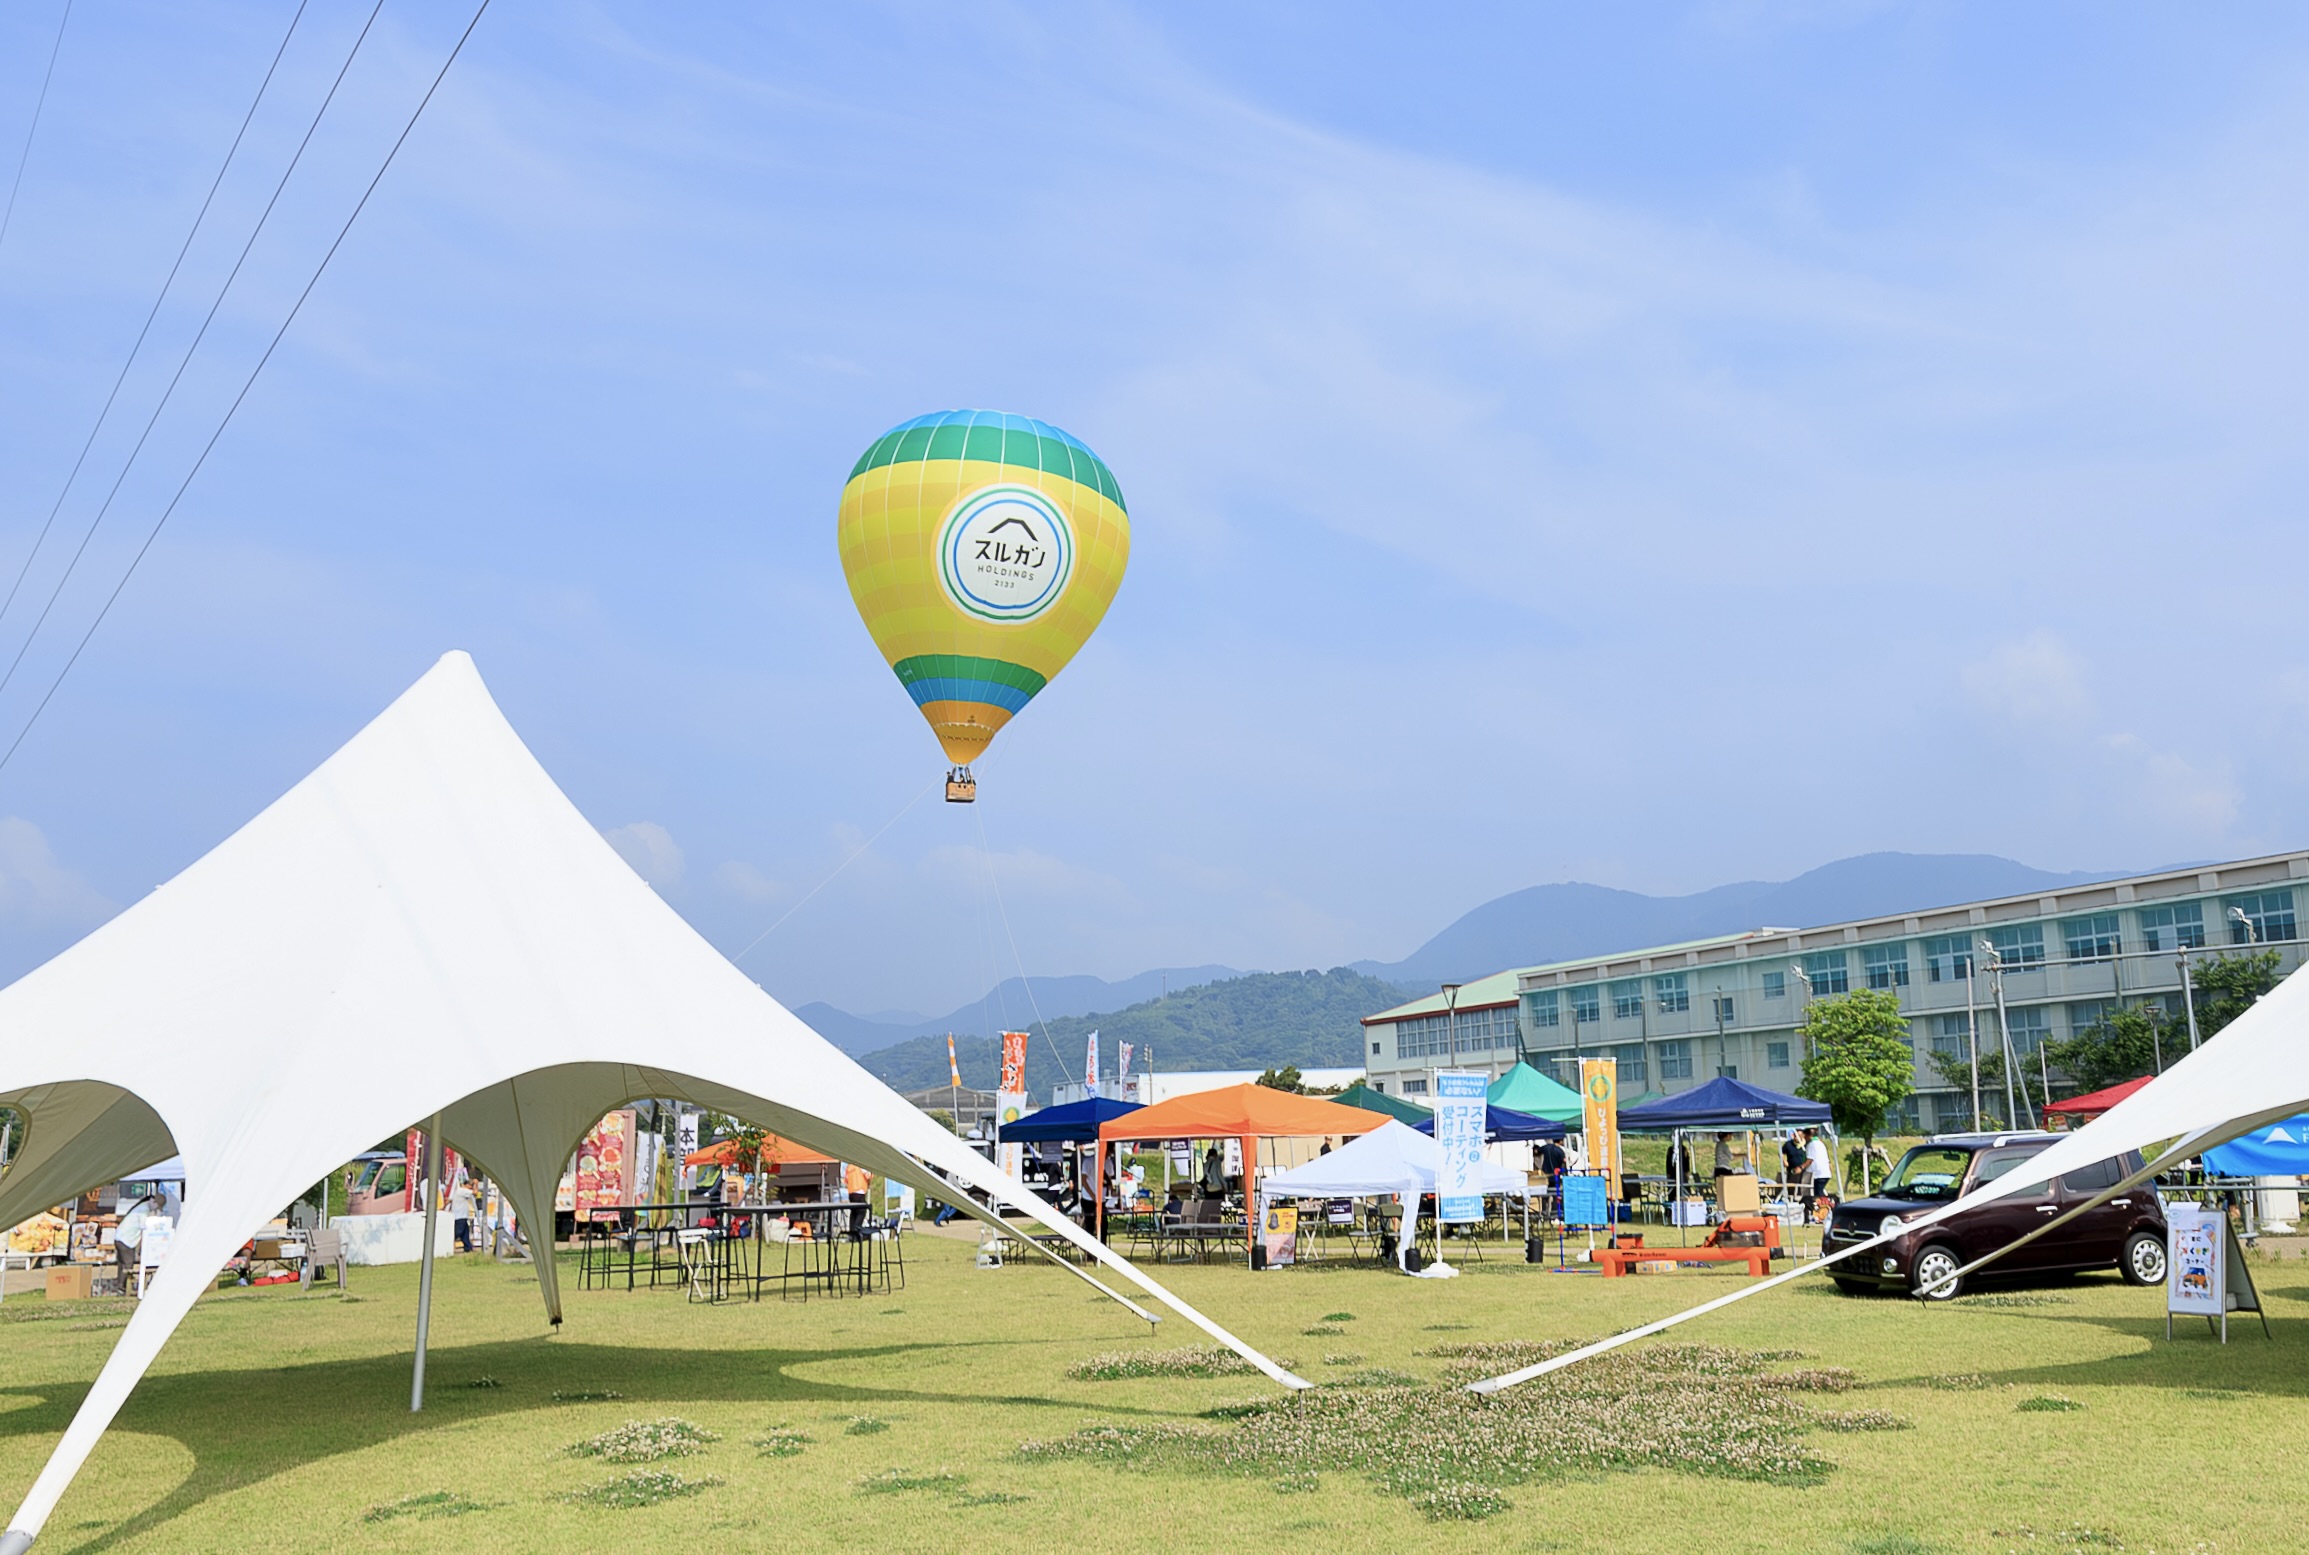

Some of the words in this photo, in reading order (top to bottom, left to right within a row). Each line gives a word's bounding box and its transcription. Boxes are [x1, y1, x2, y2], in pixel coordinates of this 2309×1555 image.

[977, 564, 1035, 581] HOLDINGS
[994, 580, 1015, 588] 2133
[1455, 1105, 1469, 1189] コーティング
